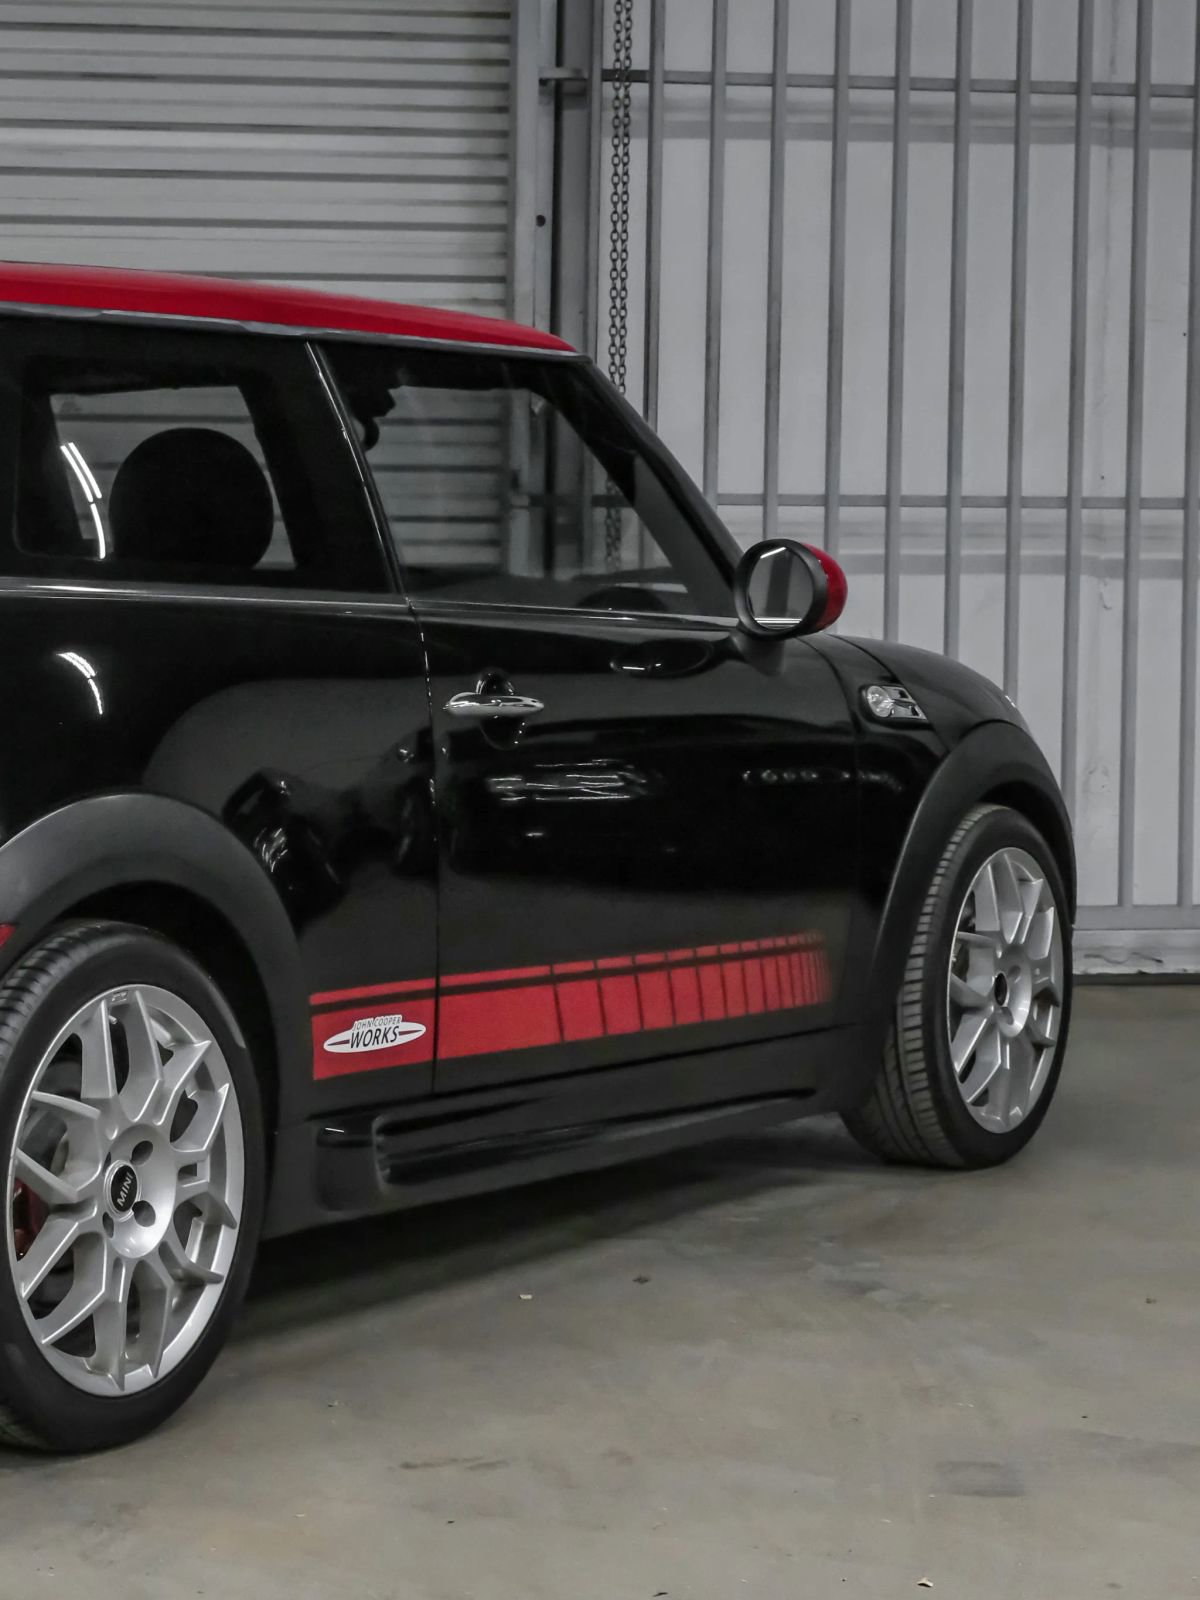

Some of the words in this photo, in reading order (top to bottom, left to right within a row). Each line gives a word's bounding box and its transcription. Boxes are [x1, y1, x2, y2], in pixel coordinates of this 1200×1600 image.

[352, 1019, 374, 1031] JOHN
[374, 1017, 401, 1027] COOPER
[350, 1026, 399, 1049] WORKS
[116, 1172, 135, 1207] MINI
